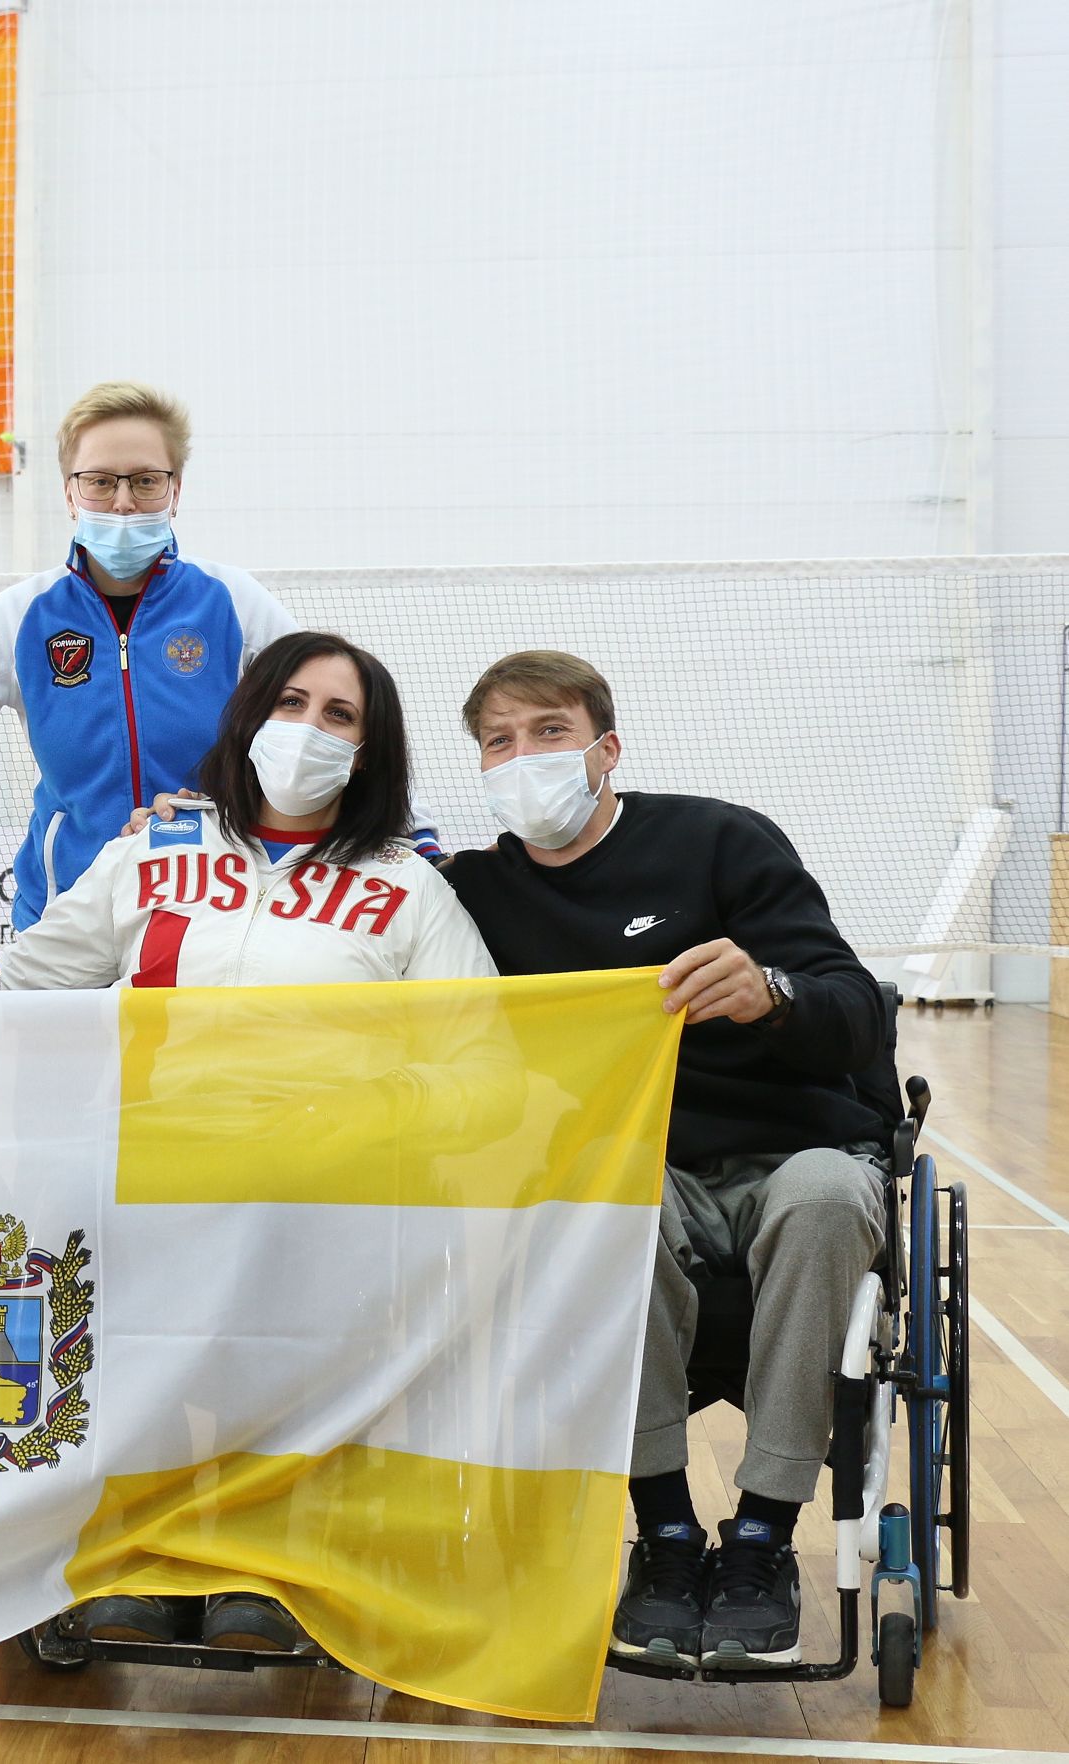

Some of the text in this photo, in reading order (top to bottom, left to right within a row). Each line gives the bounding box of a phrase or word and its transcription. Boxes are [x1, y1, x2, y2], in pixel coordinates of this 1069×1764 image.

[52, 639, 87, 649] FORWARD
[630, 915, 656, 929] NIKE
[745, 1521, 766, 1532] NIKE
